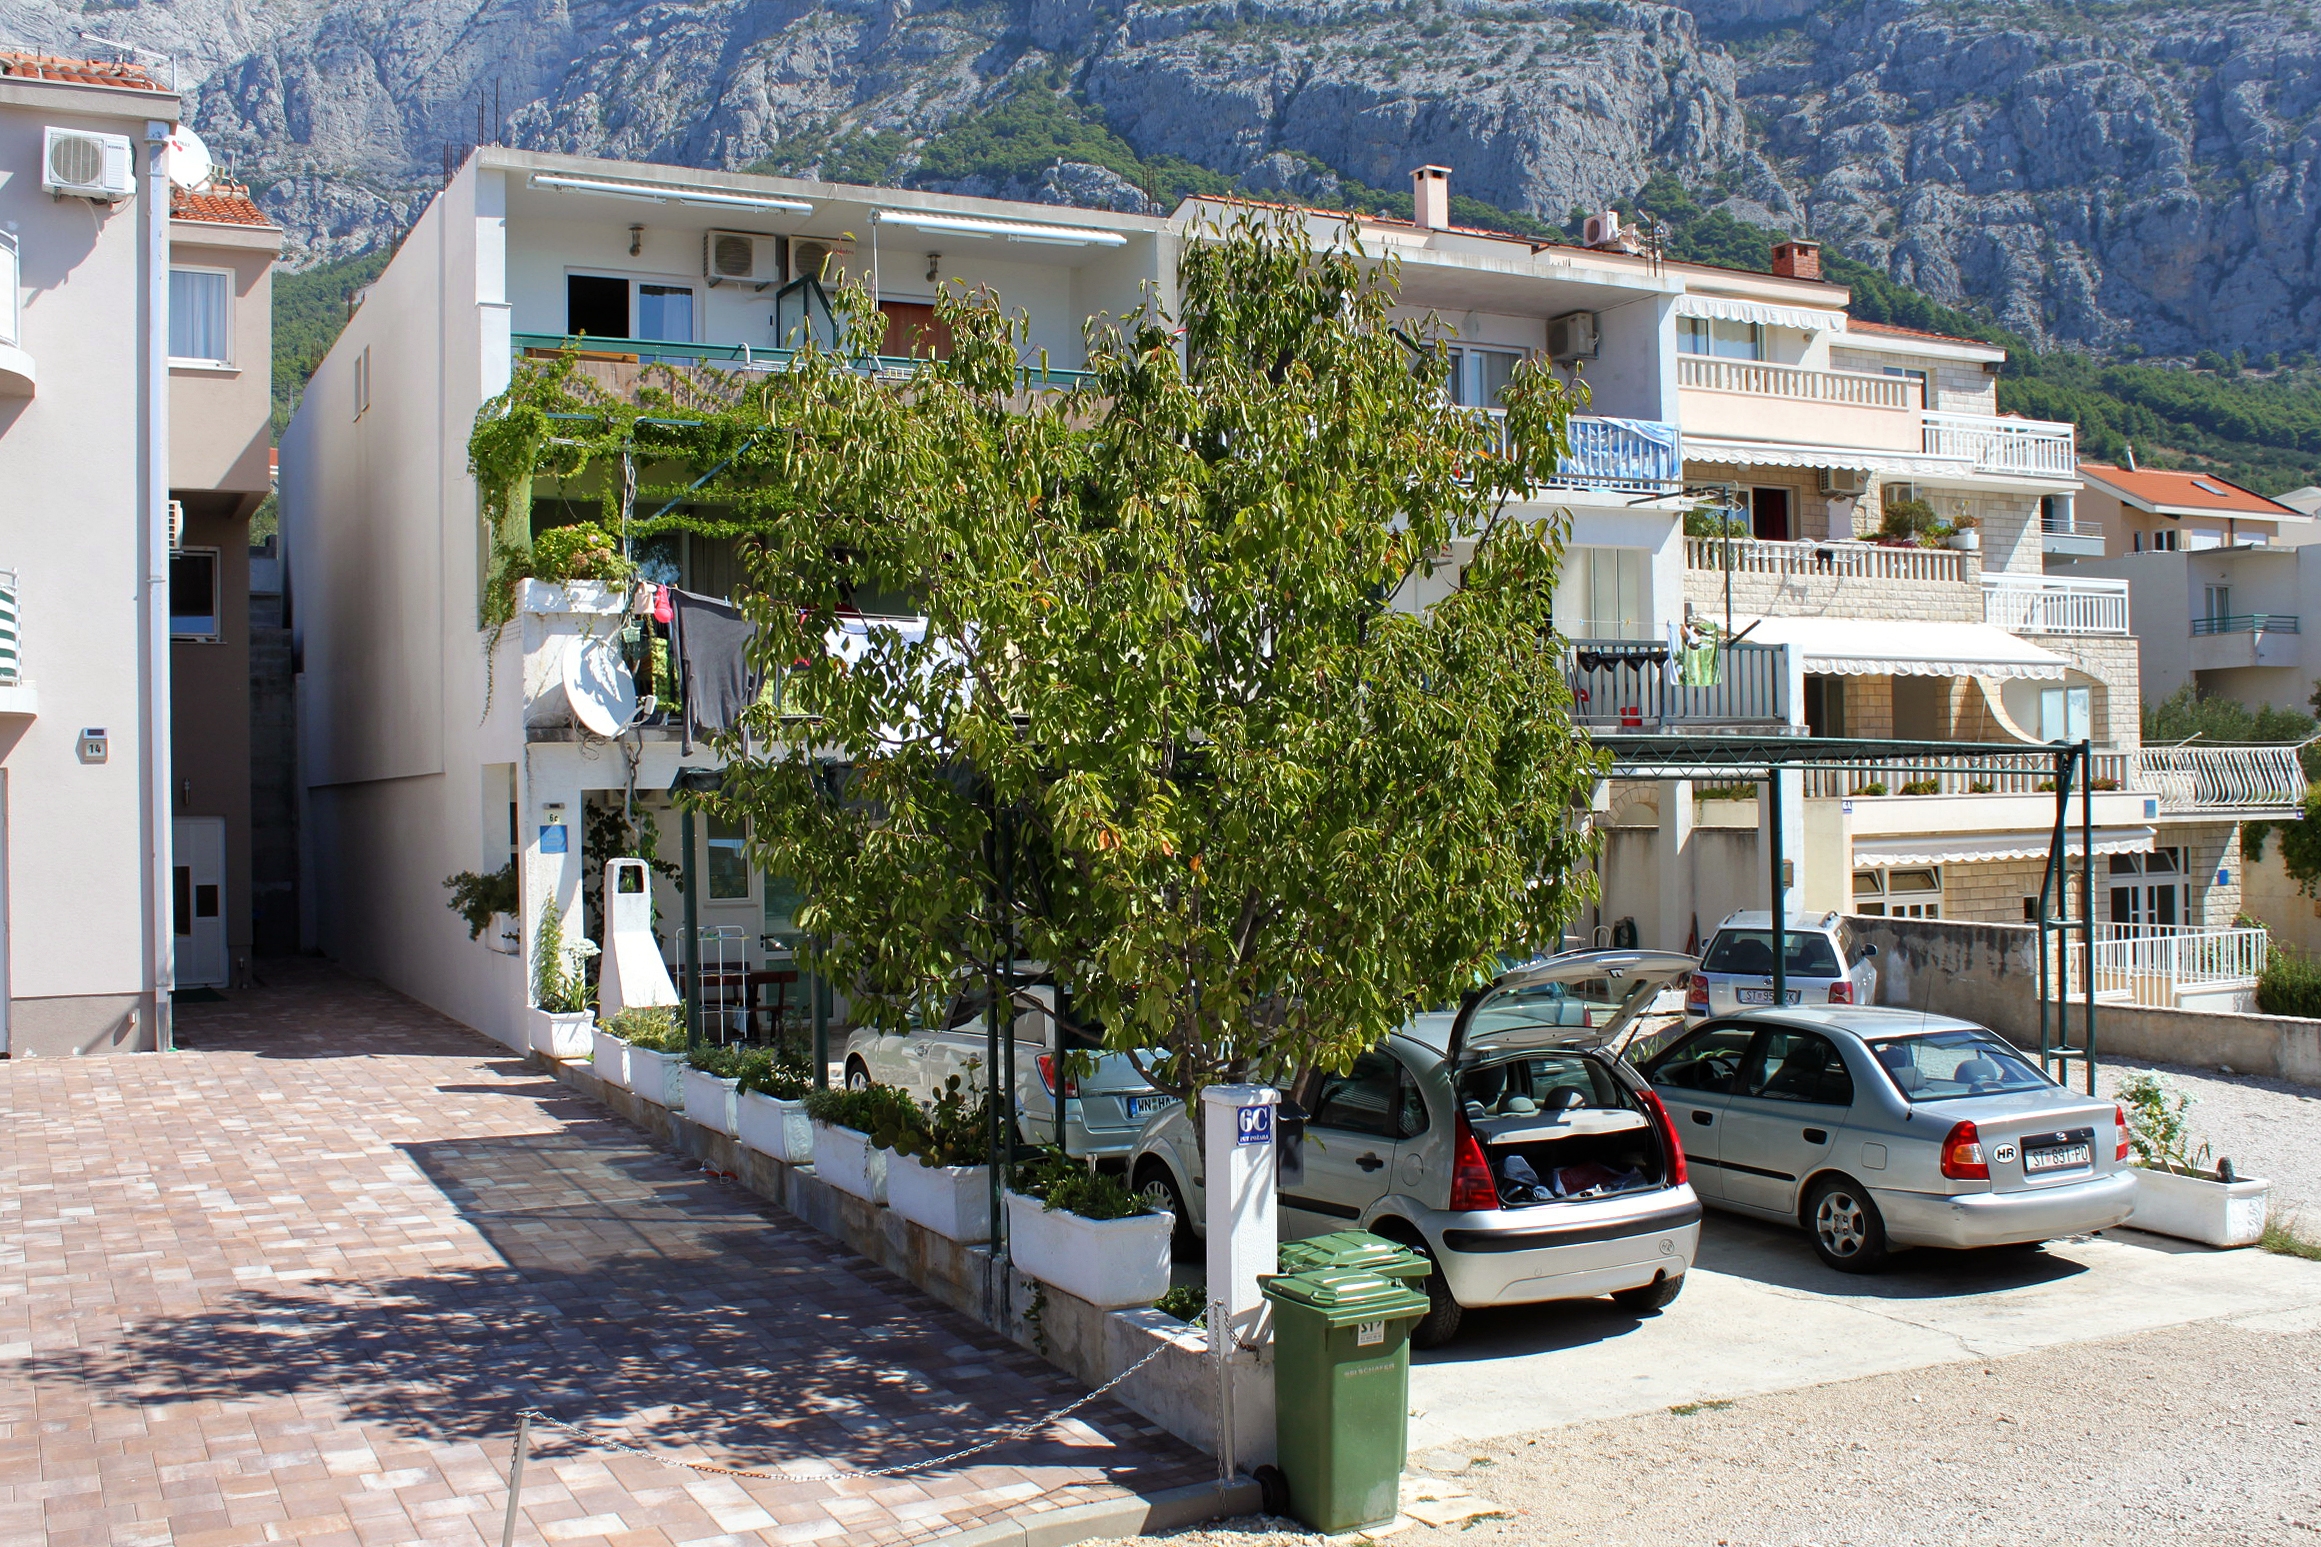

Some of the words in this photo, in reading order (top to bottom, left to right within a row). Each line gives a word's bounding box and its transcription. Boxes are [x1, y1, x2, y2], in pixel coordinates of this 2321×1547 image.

[89, 744, 102, 754] 14
[1746, 991, 1756, 1001] ST
[1137, 1098, 1152, 1112] WN
[1239, 1107, 1268, 1133] 6C
[1996, 1147, 2015, 1160] HR
